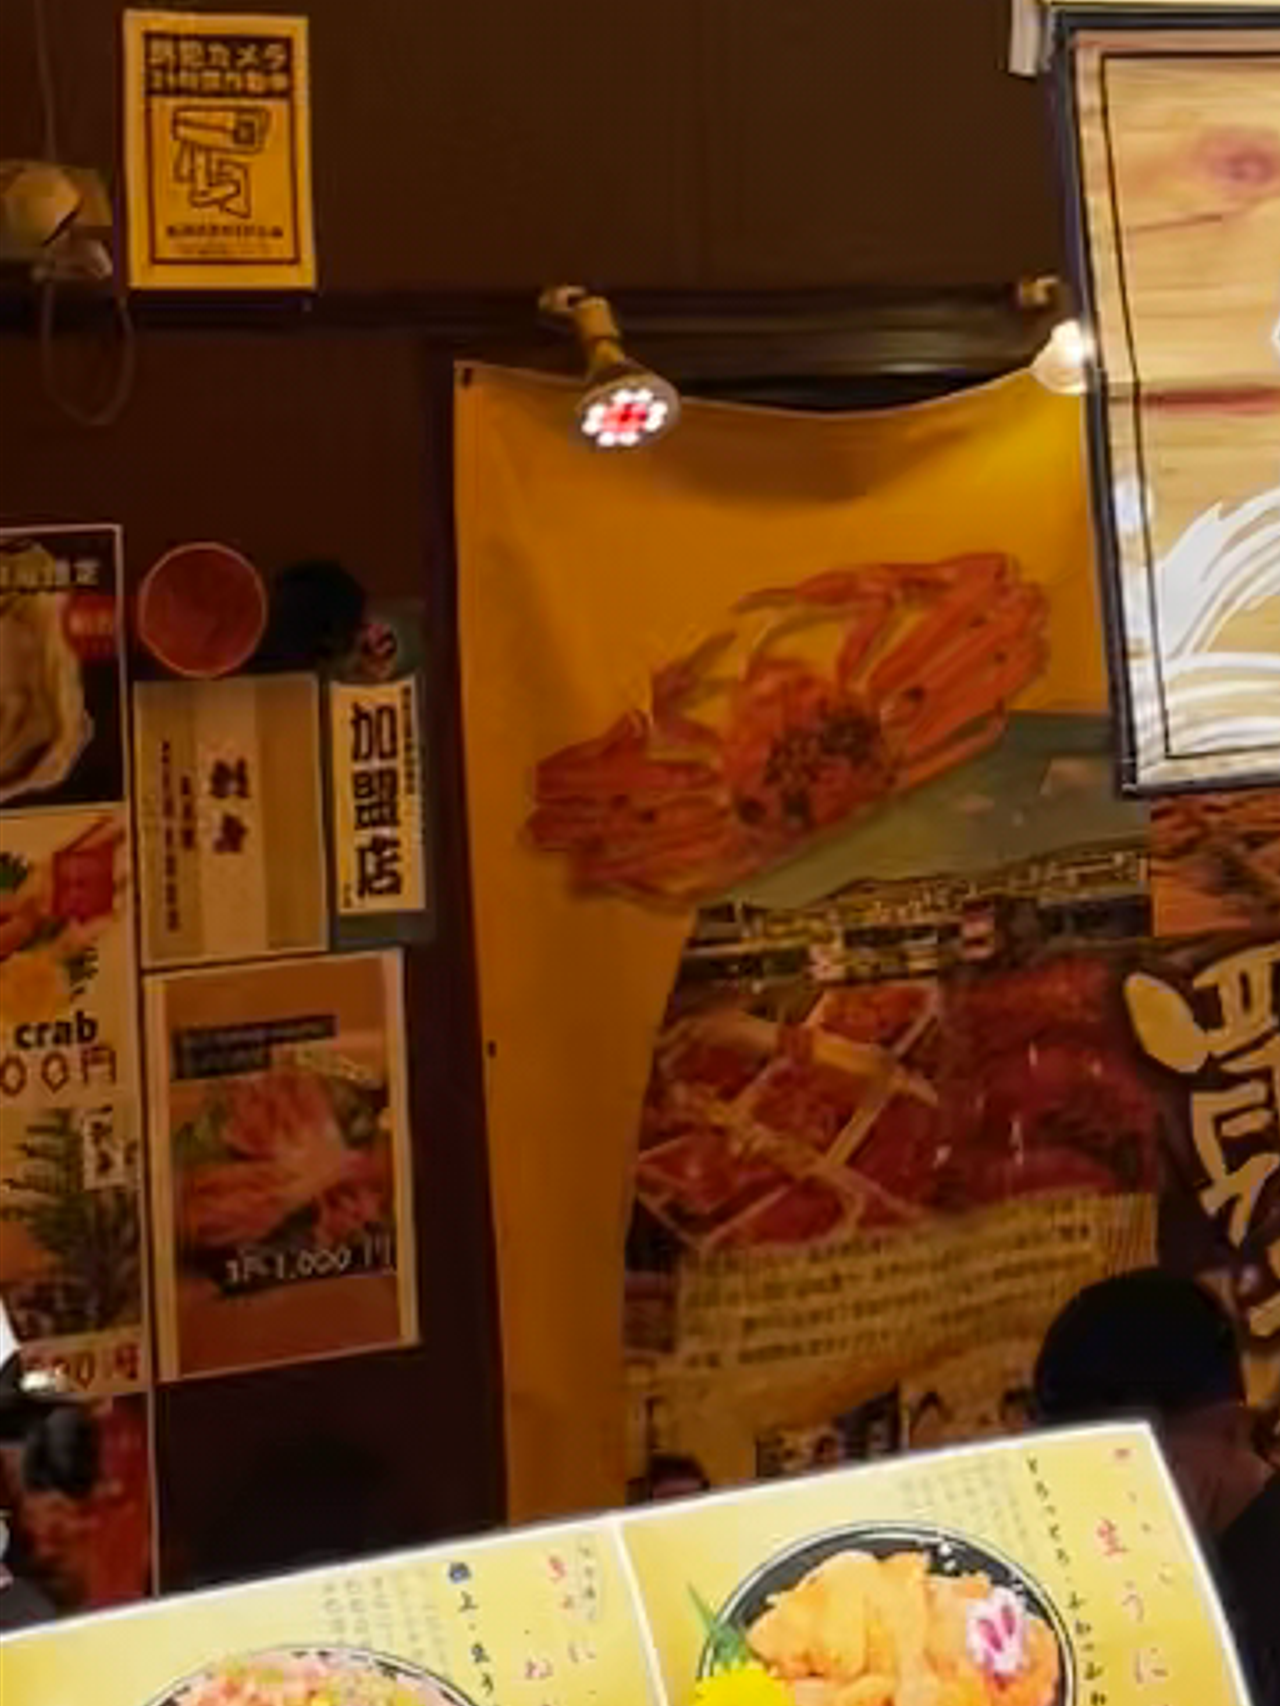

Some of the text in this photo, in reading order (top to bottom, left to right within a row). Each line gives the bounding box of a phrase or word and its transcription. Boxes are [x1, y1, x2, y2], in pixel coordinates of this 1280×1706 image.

[350, 701, 403, 898] 加盟店
[14, 1011, 98, 1049] crab
